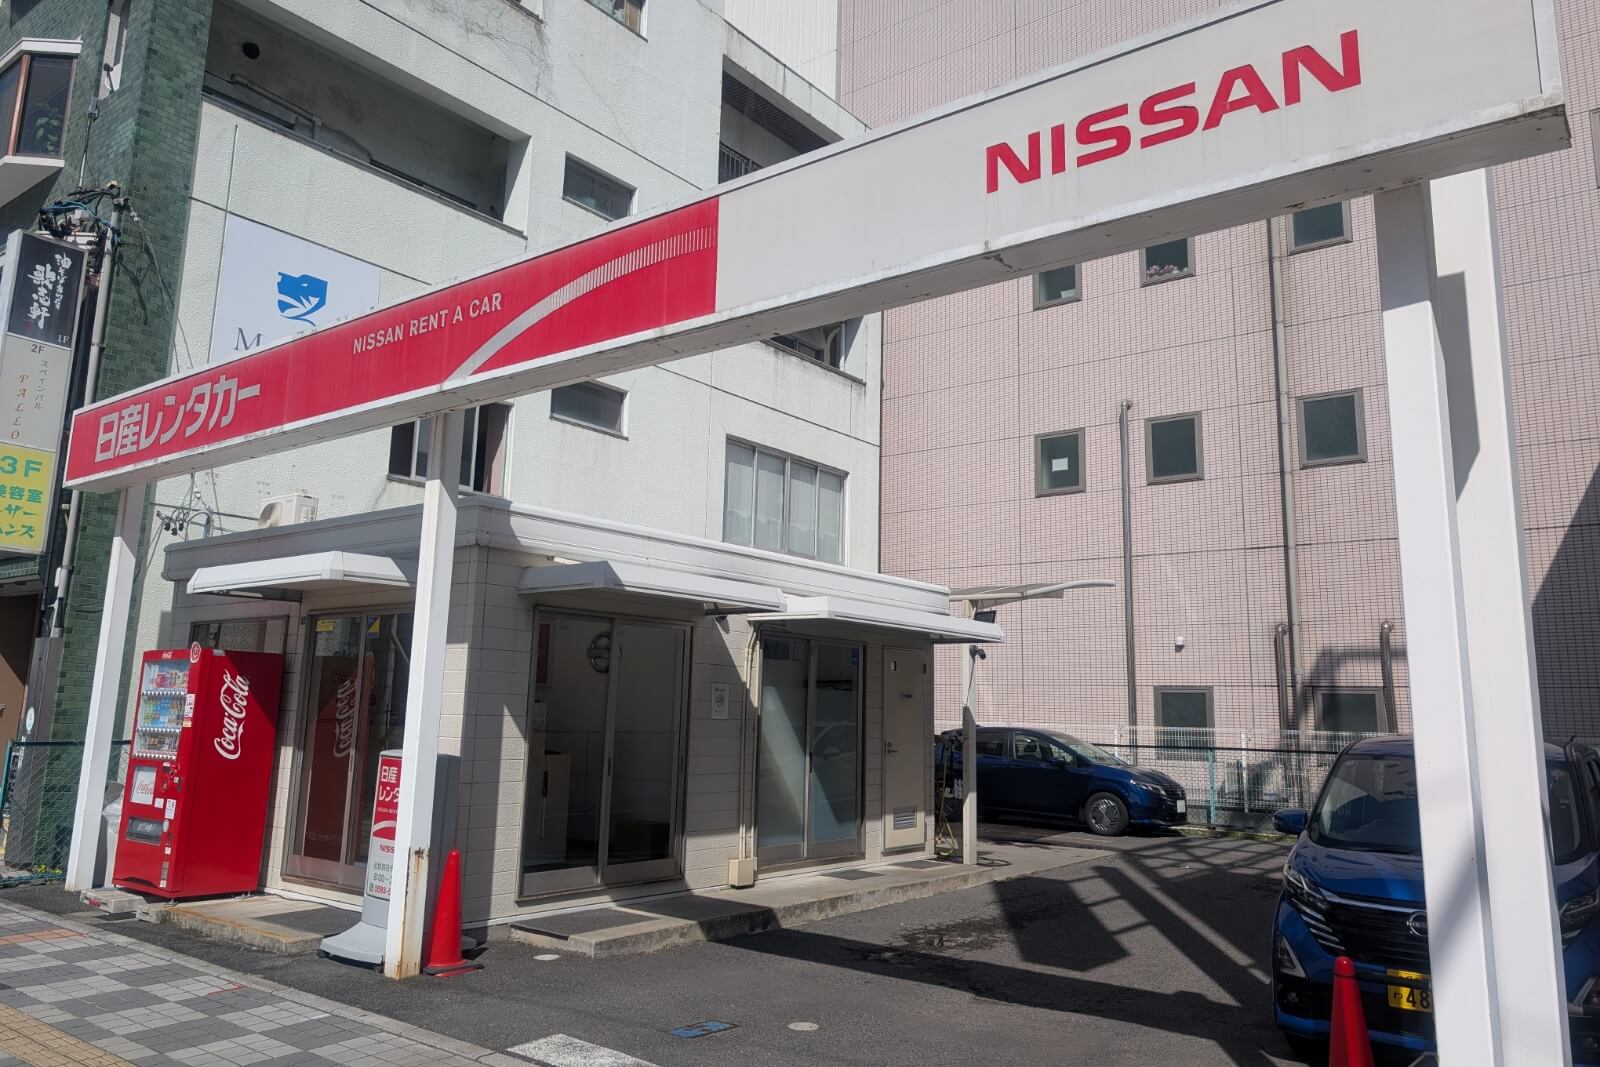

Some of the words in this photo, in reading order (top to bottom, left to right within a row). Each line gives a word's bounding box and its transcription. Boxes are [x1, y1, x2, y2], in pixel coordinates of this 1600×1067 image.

[986, 29, 1361, 194] NISSAN
[57, 334, 70, 343] 1F
[353, 323, 403, 354] NISSAN
[409, 309, 448, 337] RENT
[452, 305, 463, 324] A
[469, 292, 501, 318] CAR
[31, 344, 46, 353] 2F
[95, 375, 260, 463] 日産レンタカー
[0, 455, 42, 477] 3F
[214, 668, 250, 760] Coca-Cola
[380, 765, 398, 783] 日産
